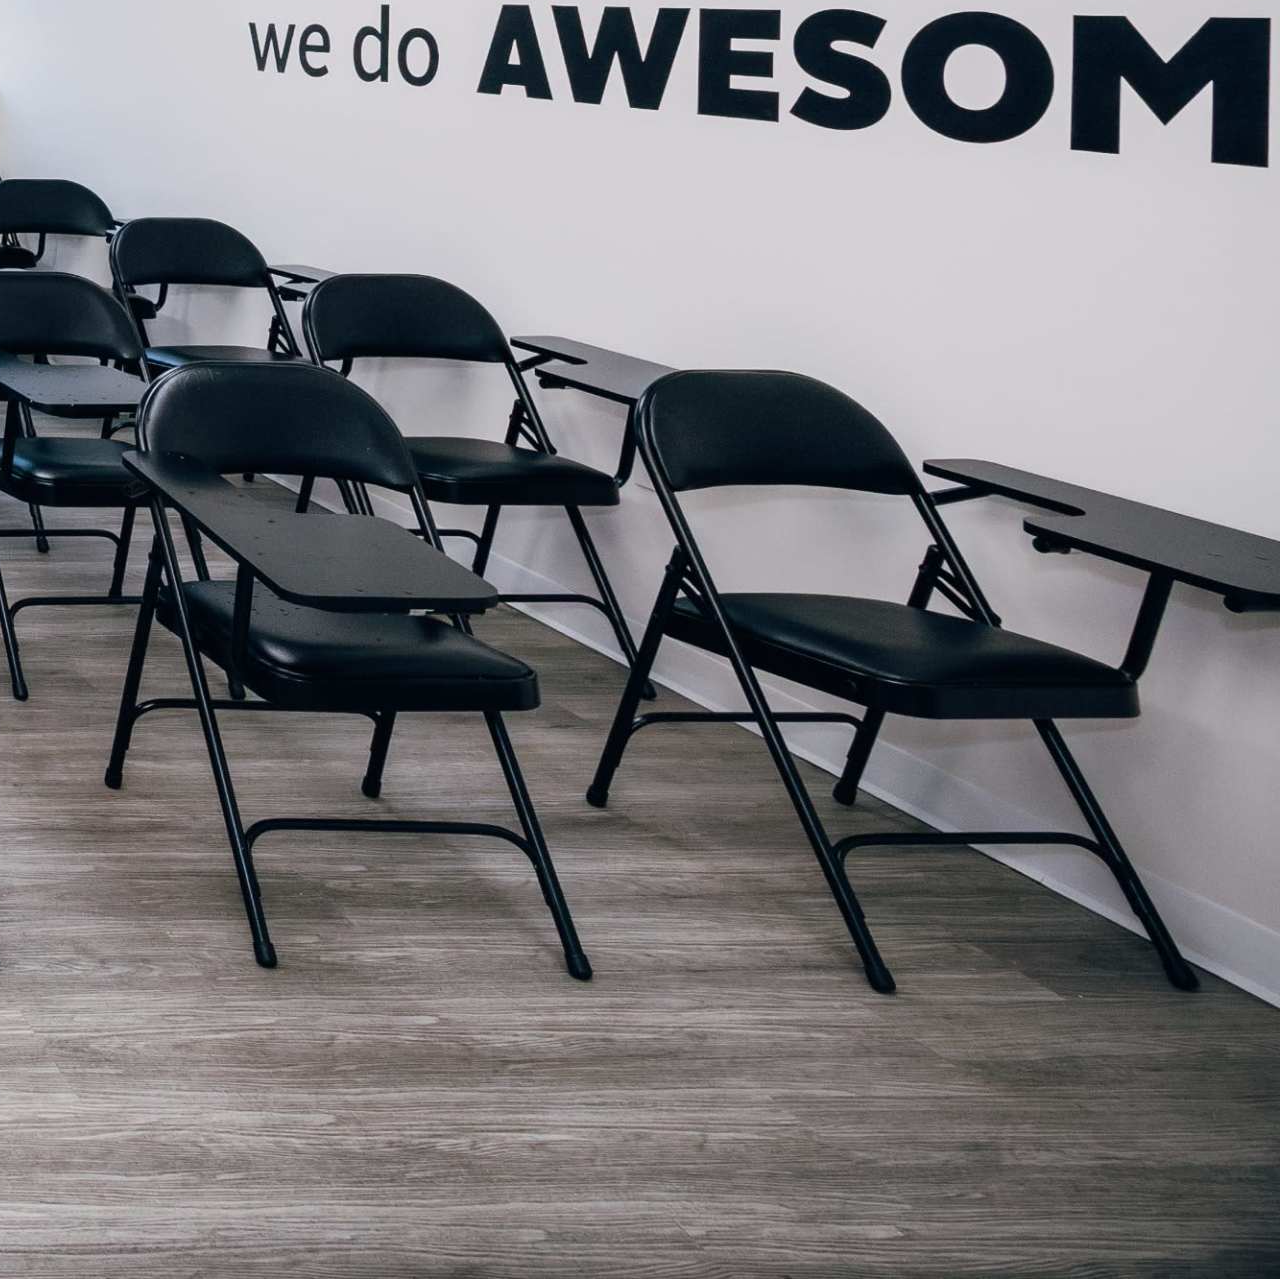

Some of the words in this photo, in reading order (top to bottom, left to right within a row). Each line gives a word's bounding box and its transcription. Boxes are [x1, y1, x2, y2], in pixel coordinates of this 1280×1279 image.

[248, 22, 331, 78] we
[353, 4, 440, 87] do
[476, 4, 1272, 169] AWESOM
